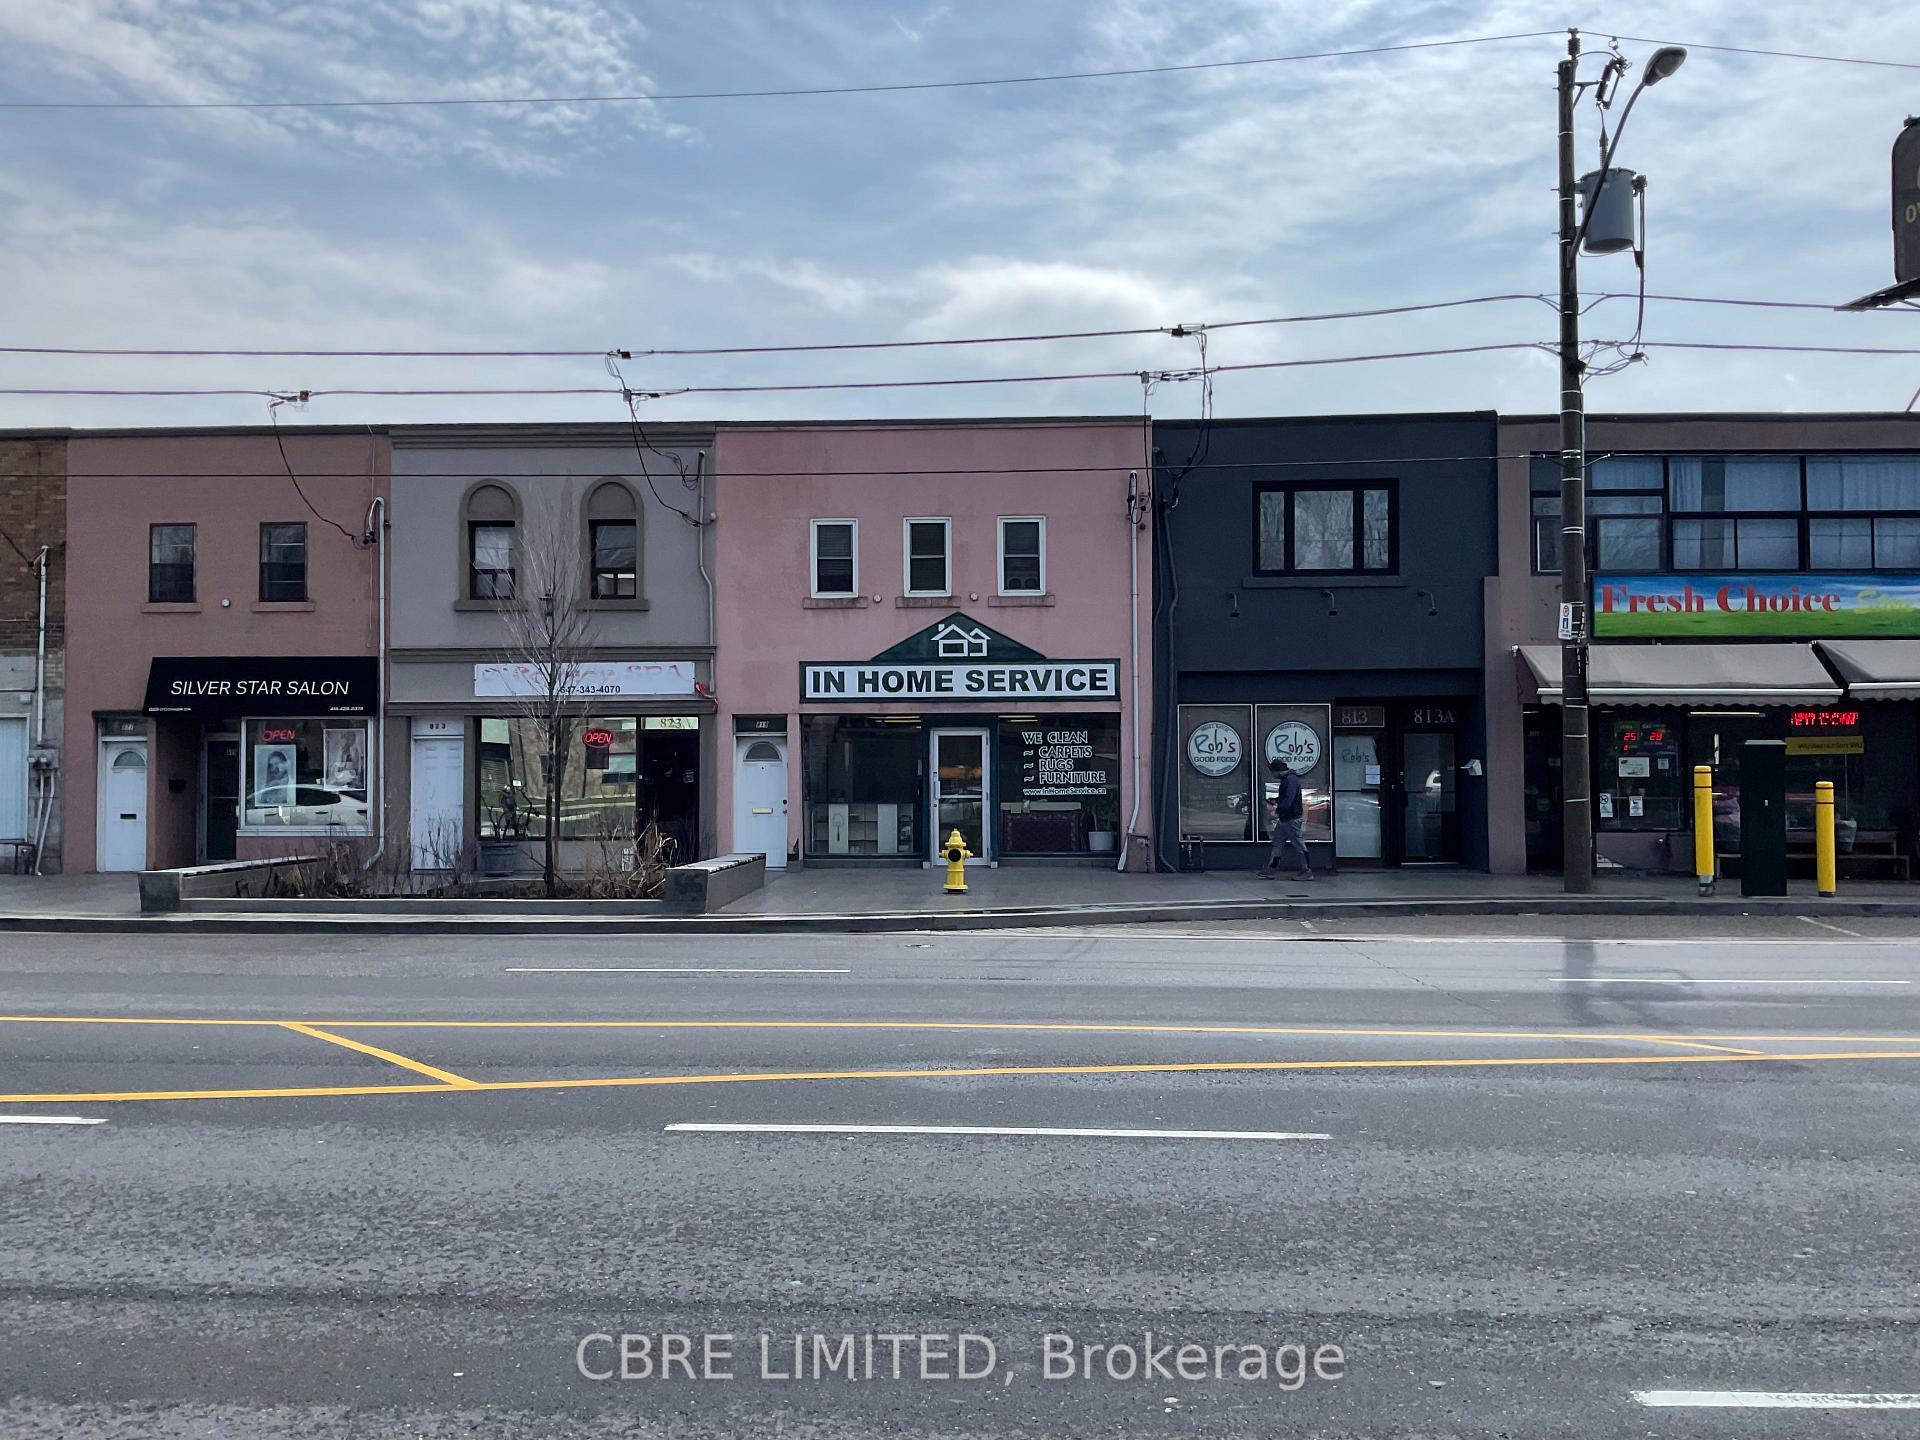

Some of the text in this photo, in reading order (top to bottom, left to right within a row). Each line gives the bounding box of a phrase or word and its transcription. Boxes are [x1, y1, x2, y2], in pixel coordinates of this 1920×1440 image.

[1600, 584, 1705, 614] Fresh
[1716, 584, 1842, 613] Choice
[170, 680, 349, 695] SILVER STAR SALON
[812, 668, 1108, 693] IN HOME SERVICE
[1341, 710, 1368, 724] 813
[1413, 709, 1456, 723] 813A
[262, 730, 296, 741] OPEN
[585, 732, 612, 743] OPEN
[1022, 731, 1088, 745] WE CLEAN
[1194, 728, 1236, 754] Rob's
[1274, 730, 1314, 755] Rob's
[1038, 745, 1093, 758] CARPETS
[1038, 758, 1074, 771] RUGS
[1039, 771, 1107, 784] FURNITURE
